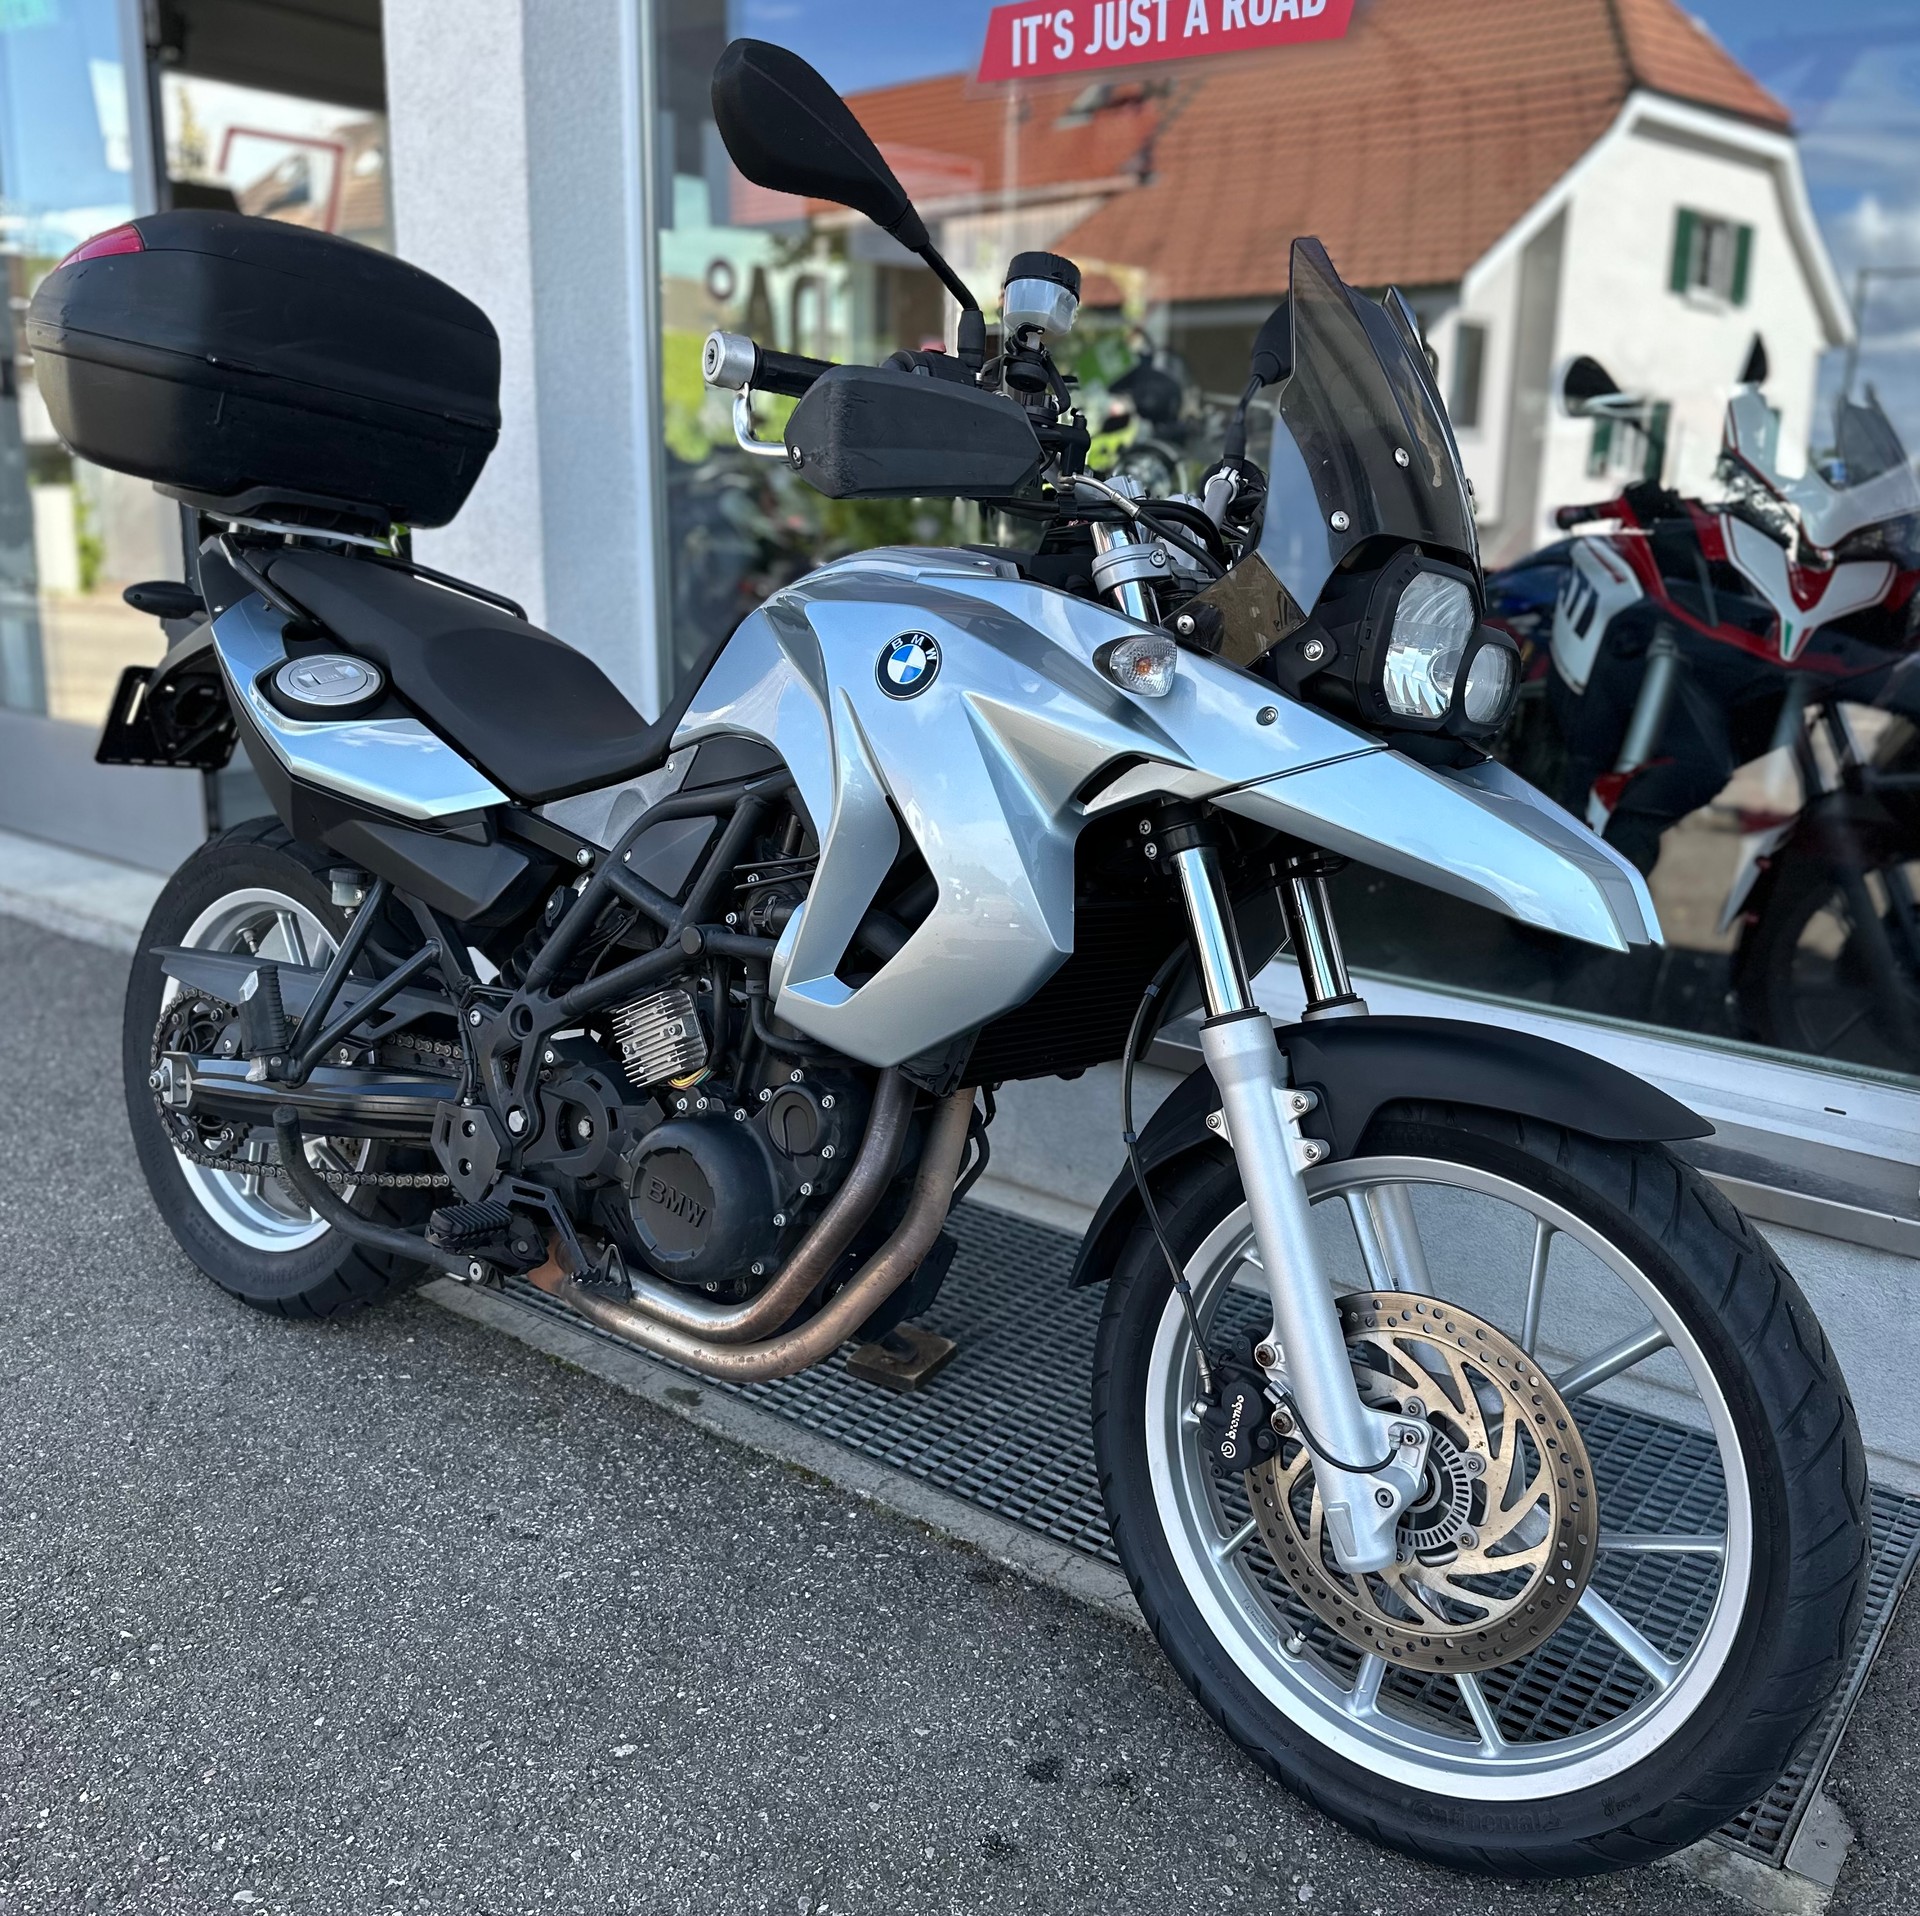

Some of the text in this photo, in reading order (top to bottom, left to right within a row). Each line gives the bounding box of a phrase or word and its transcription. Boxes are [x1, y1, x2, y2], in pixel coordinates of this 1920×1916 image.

[1012, 9, 1074, 67] IT'S
[1084, 0, 1168, 55] JUST
[1183, 0, 1209, 38] A
[891, 634, 937, 660] BMW
[647, 1176, 706, 1229] BMW
[1225, 1394, 1245, 1440] brembo
